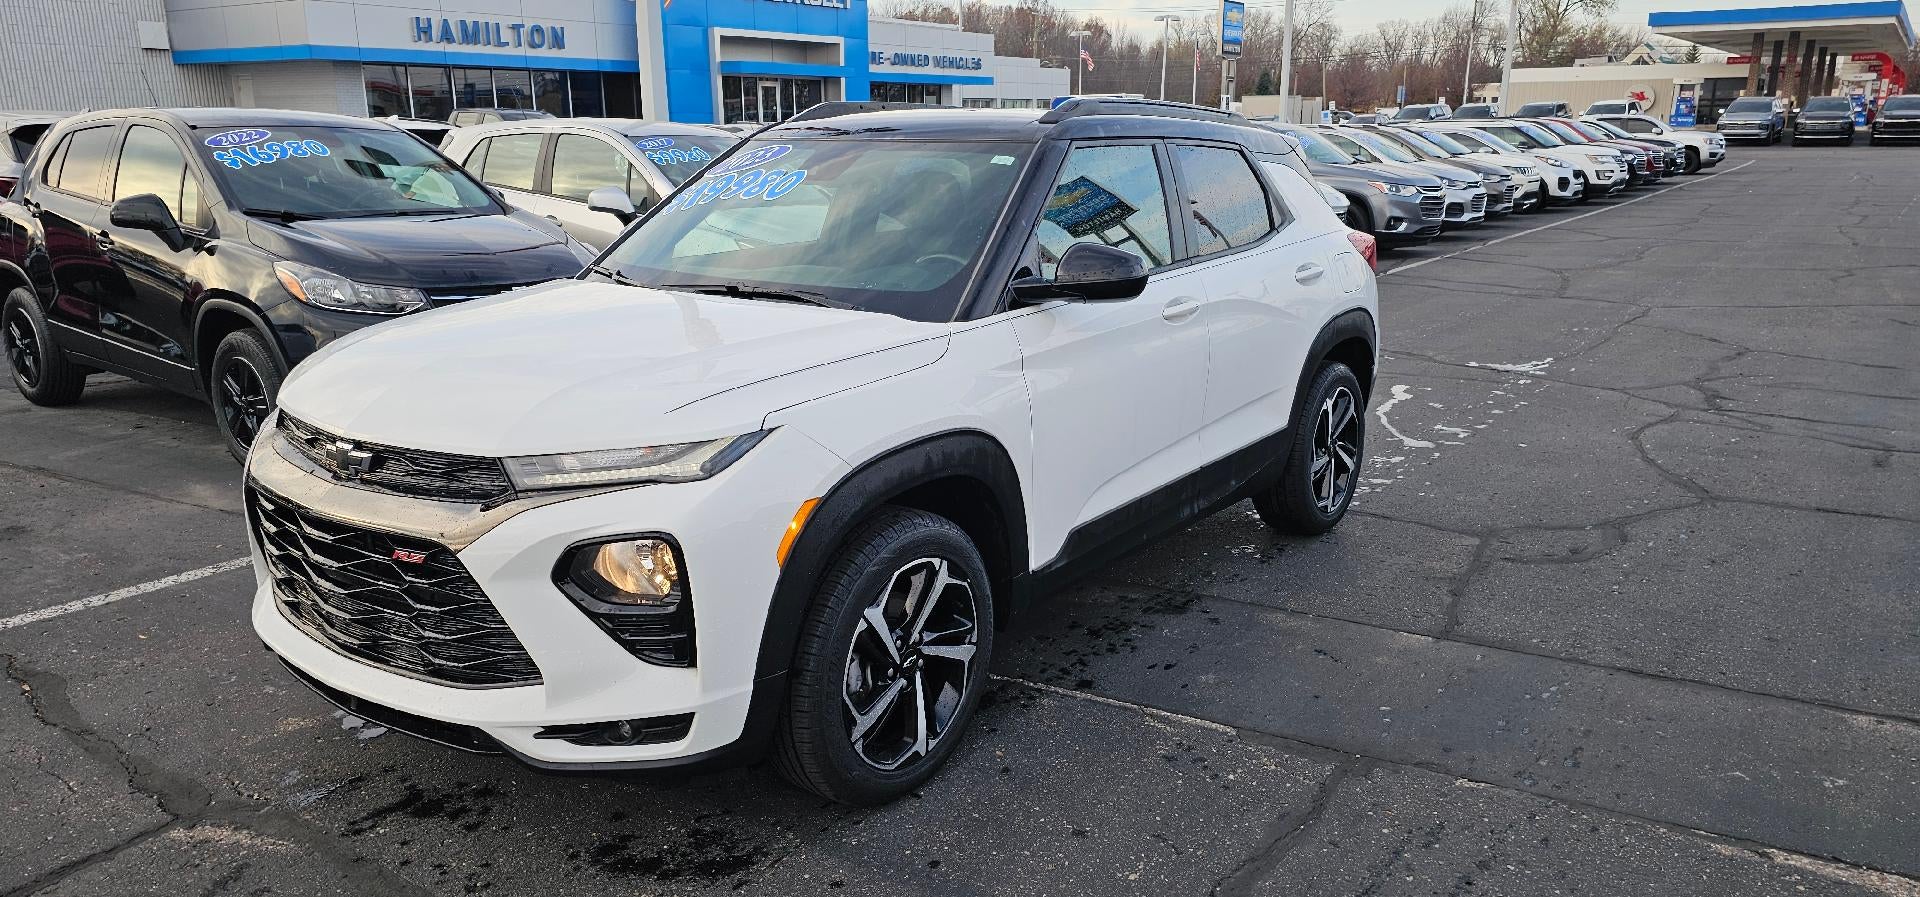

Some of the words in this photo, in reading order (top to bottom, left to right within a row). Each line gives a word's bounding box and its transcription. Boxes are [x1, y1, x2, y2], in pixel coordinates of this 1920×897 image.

[411, 16, 566, 50] HAMILTON
[870, 51, 930, 68] RE-OWNED
[932, 55, 983, 71] VEHICLES
[216, 130, 260, 146] 2022
[213, 139, 330, 170] $16980
[663, 169, 807, 216] $19980
[392, 549, 426, 564] RS
